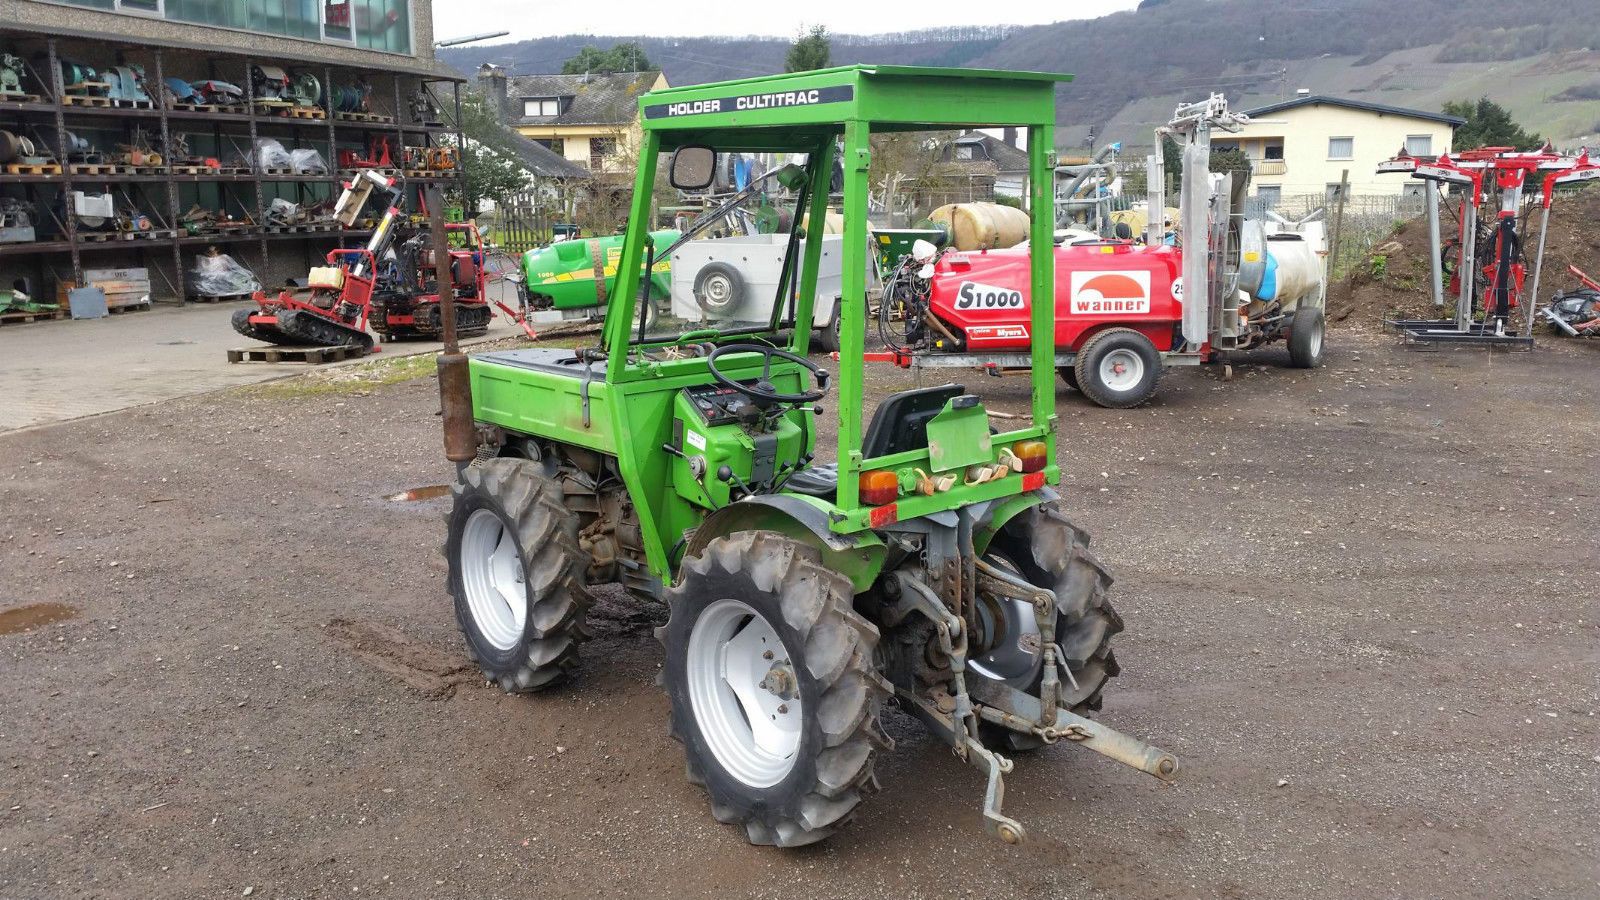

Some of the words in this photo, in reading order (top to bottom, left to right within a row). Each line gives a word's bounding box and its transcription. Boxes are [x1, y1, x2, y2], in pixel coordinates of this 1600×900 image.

[668, 99, 721, 116] HOLDER
[736, 90, 819, 110] CULTITRAC
[959, 282, 1021, 309] S1000
[1077, 300, 1145, 312] wanner
